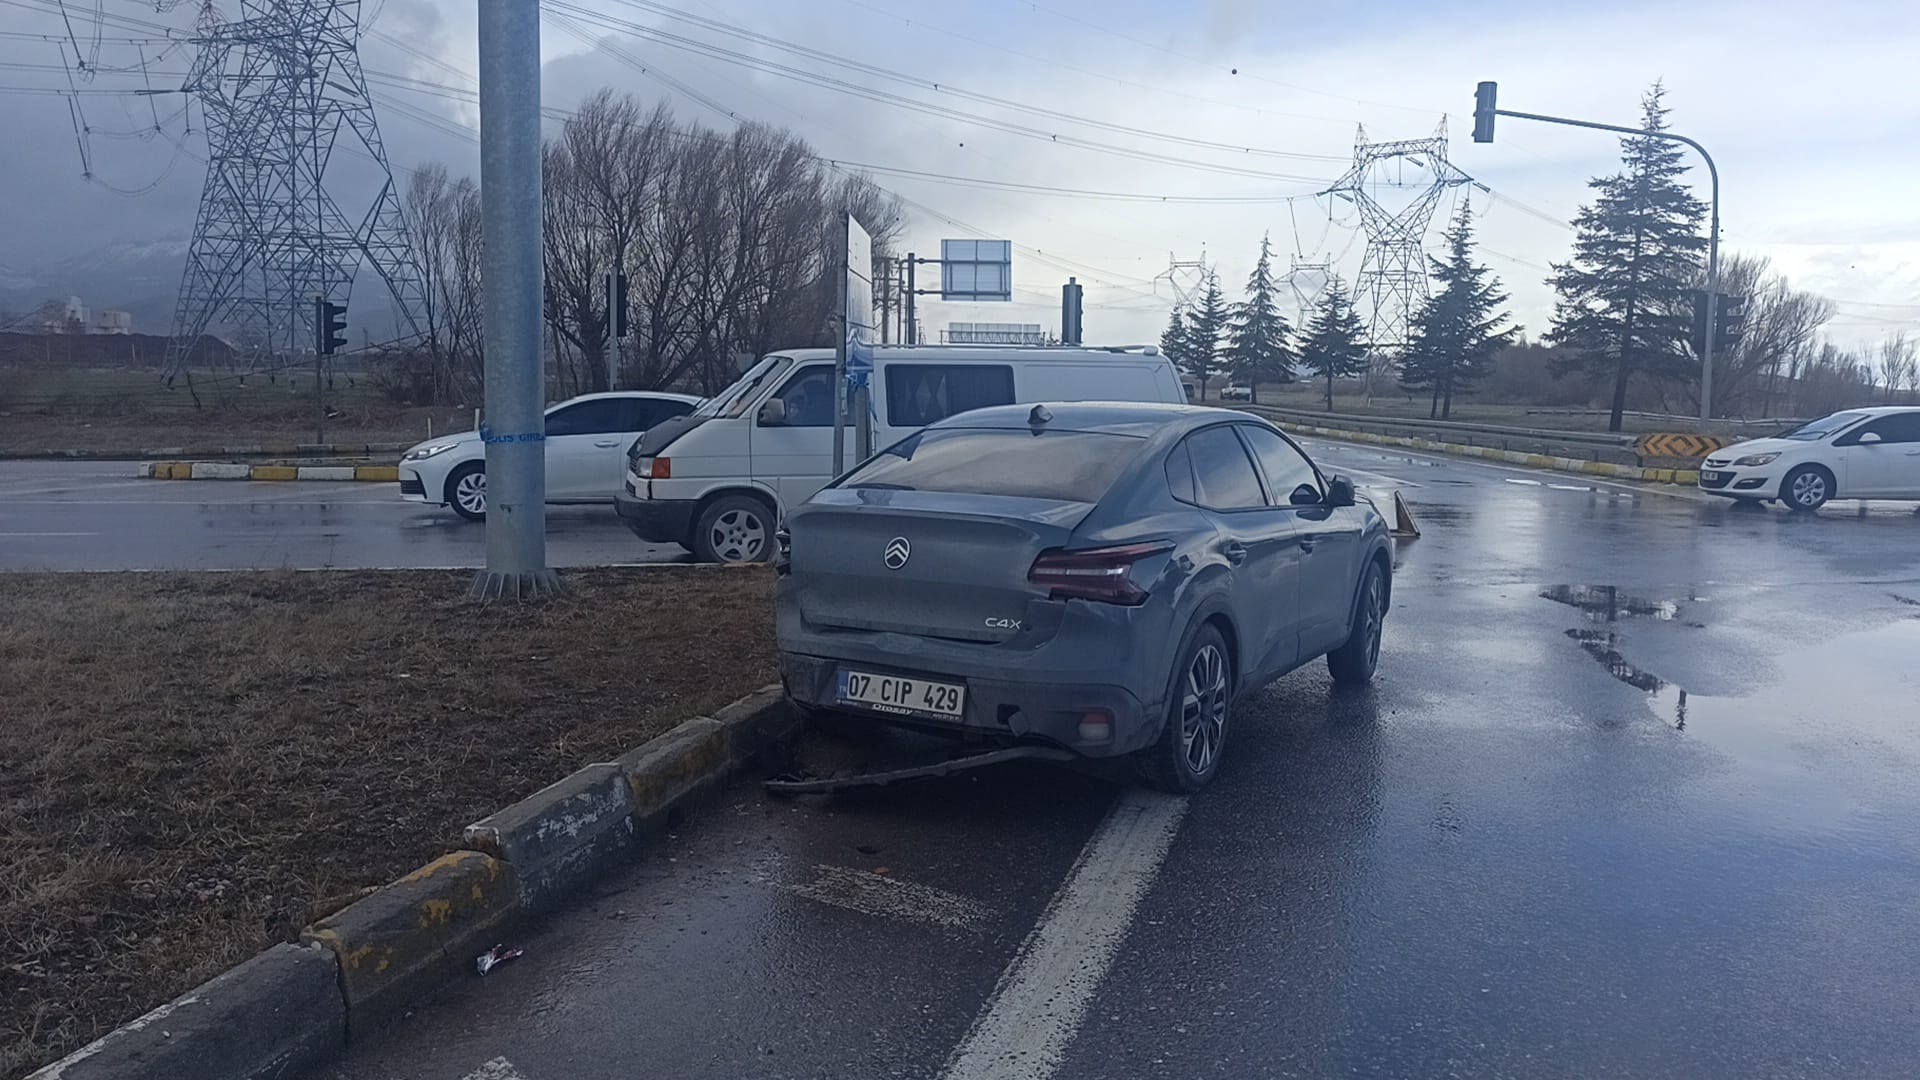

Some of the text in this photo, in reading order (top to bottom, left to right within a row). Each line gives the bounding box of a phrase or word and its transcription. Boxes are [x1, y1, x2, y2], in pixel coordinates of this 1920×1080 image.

[985, 617, 1022, 630] C4X
[848, 674, 959, 711] 07 CIP 429
